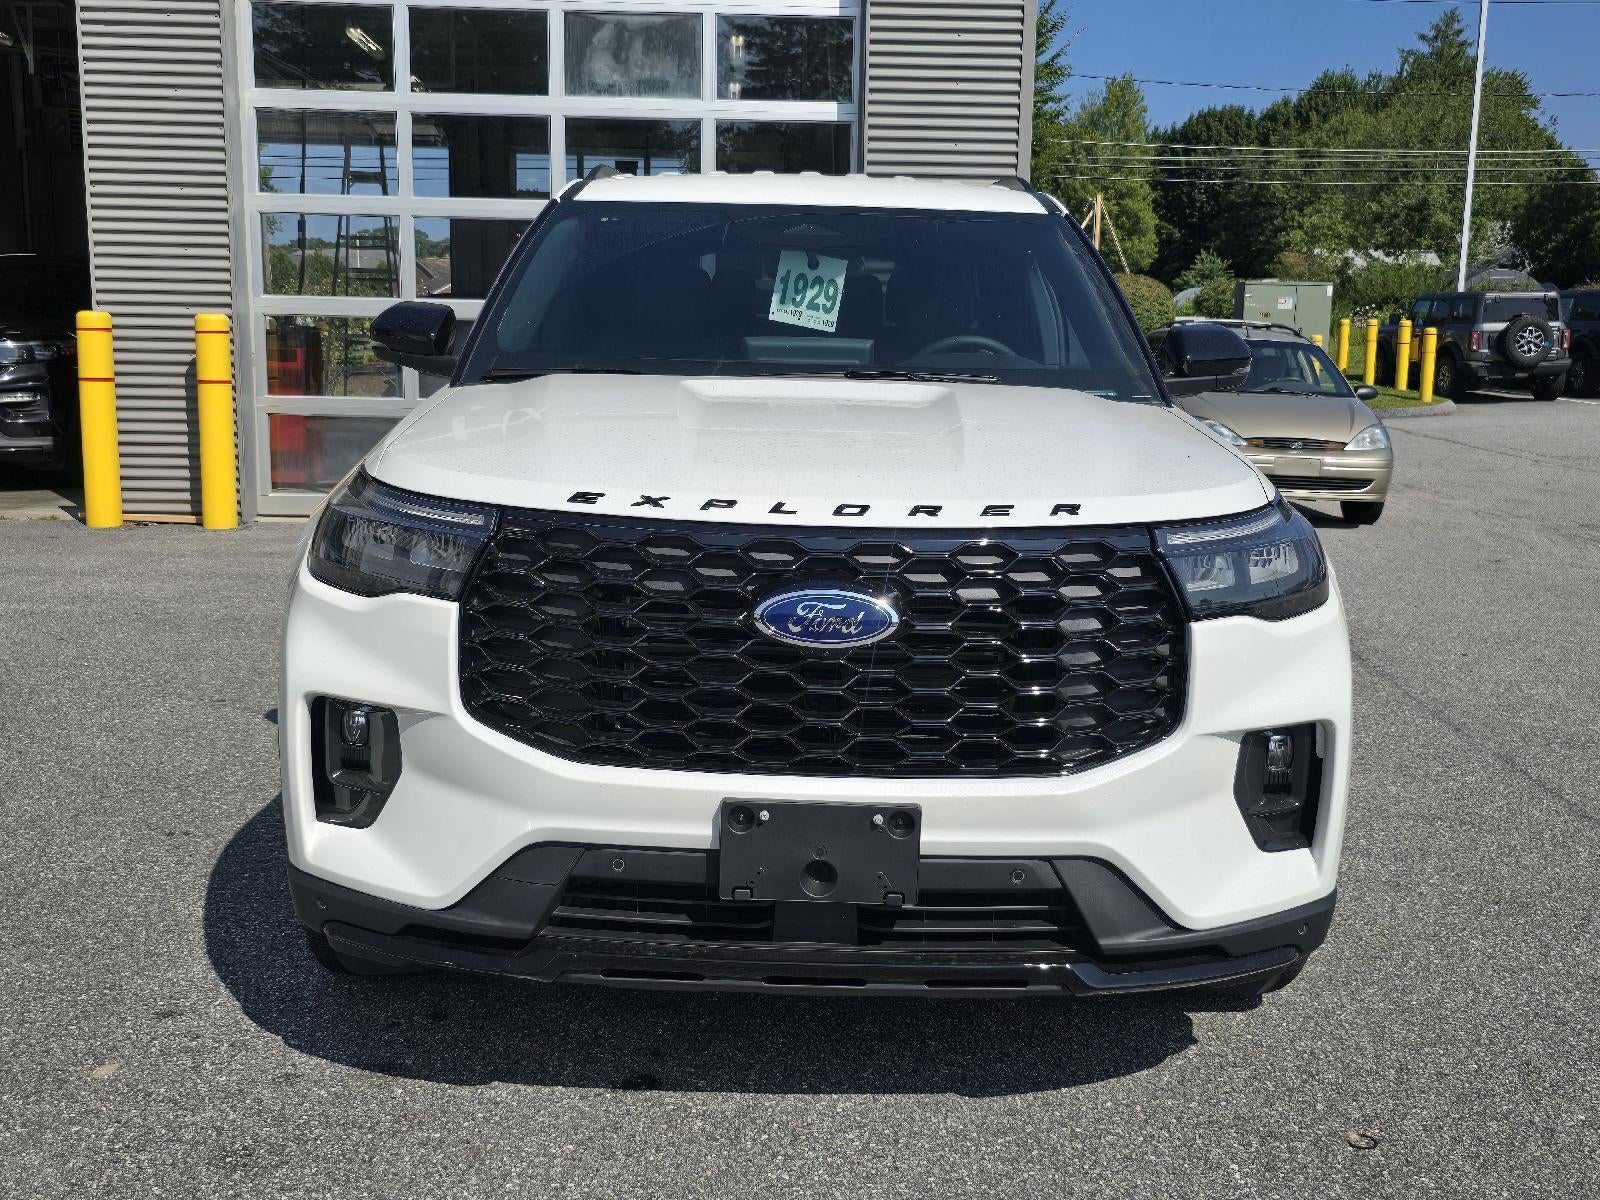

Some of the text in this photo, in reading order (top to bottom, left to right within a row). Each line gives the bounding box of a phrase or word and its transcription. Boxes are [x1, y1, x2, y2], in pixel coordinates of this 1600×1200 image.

[779, 269, 838, 315] 1929
[566, 491, 1082, 517] EXPLORER
[787, 601, 865, 635] Ford
